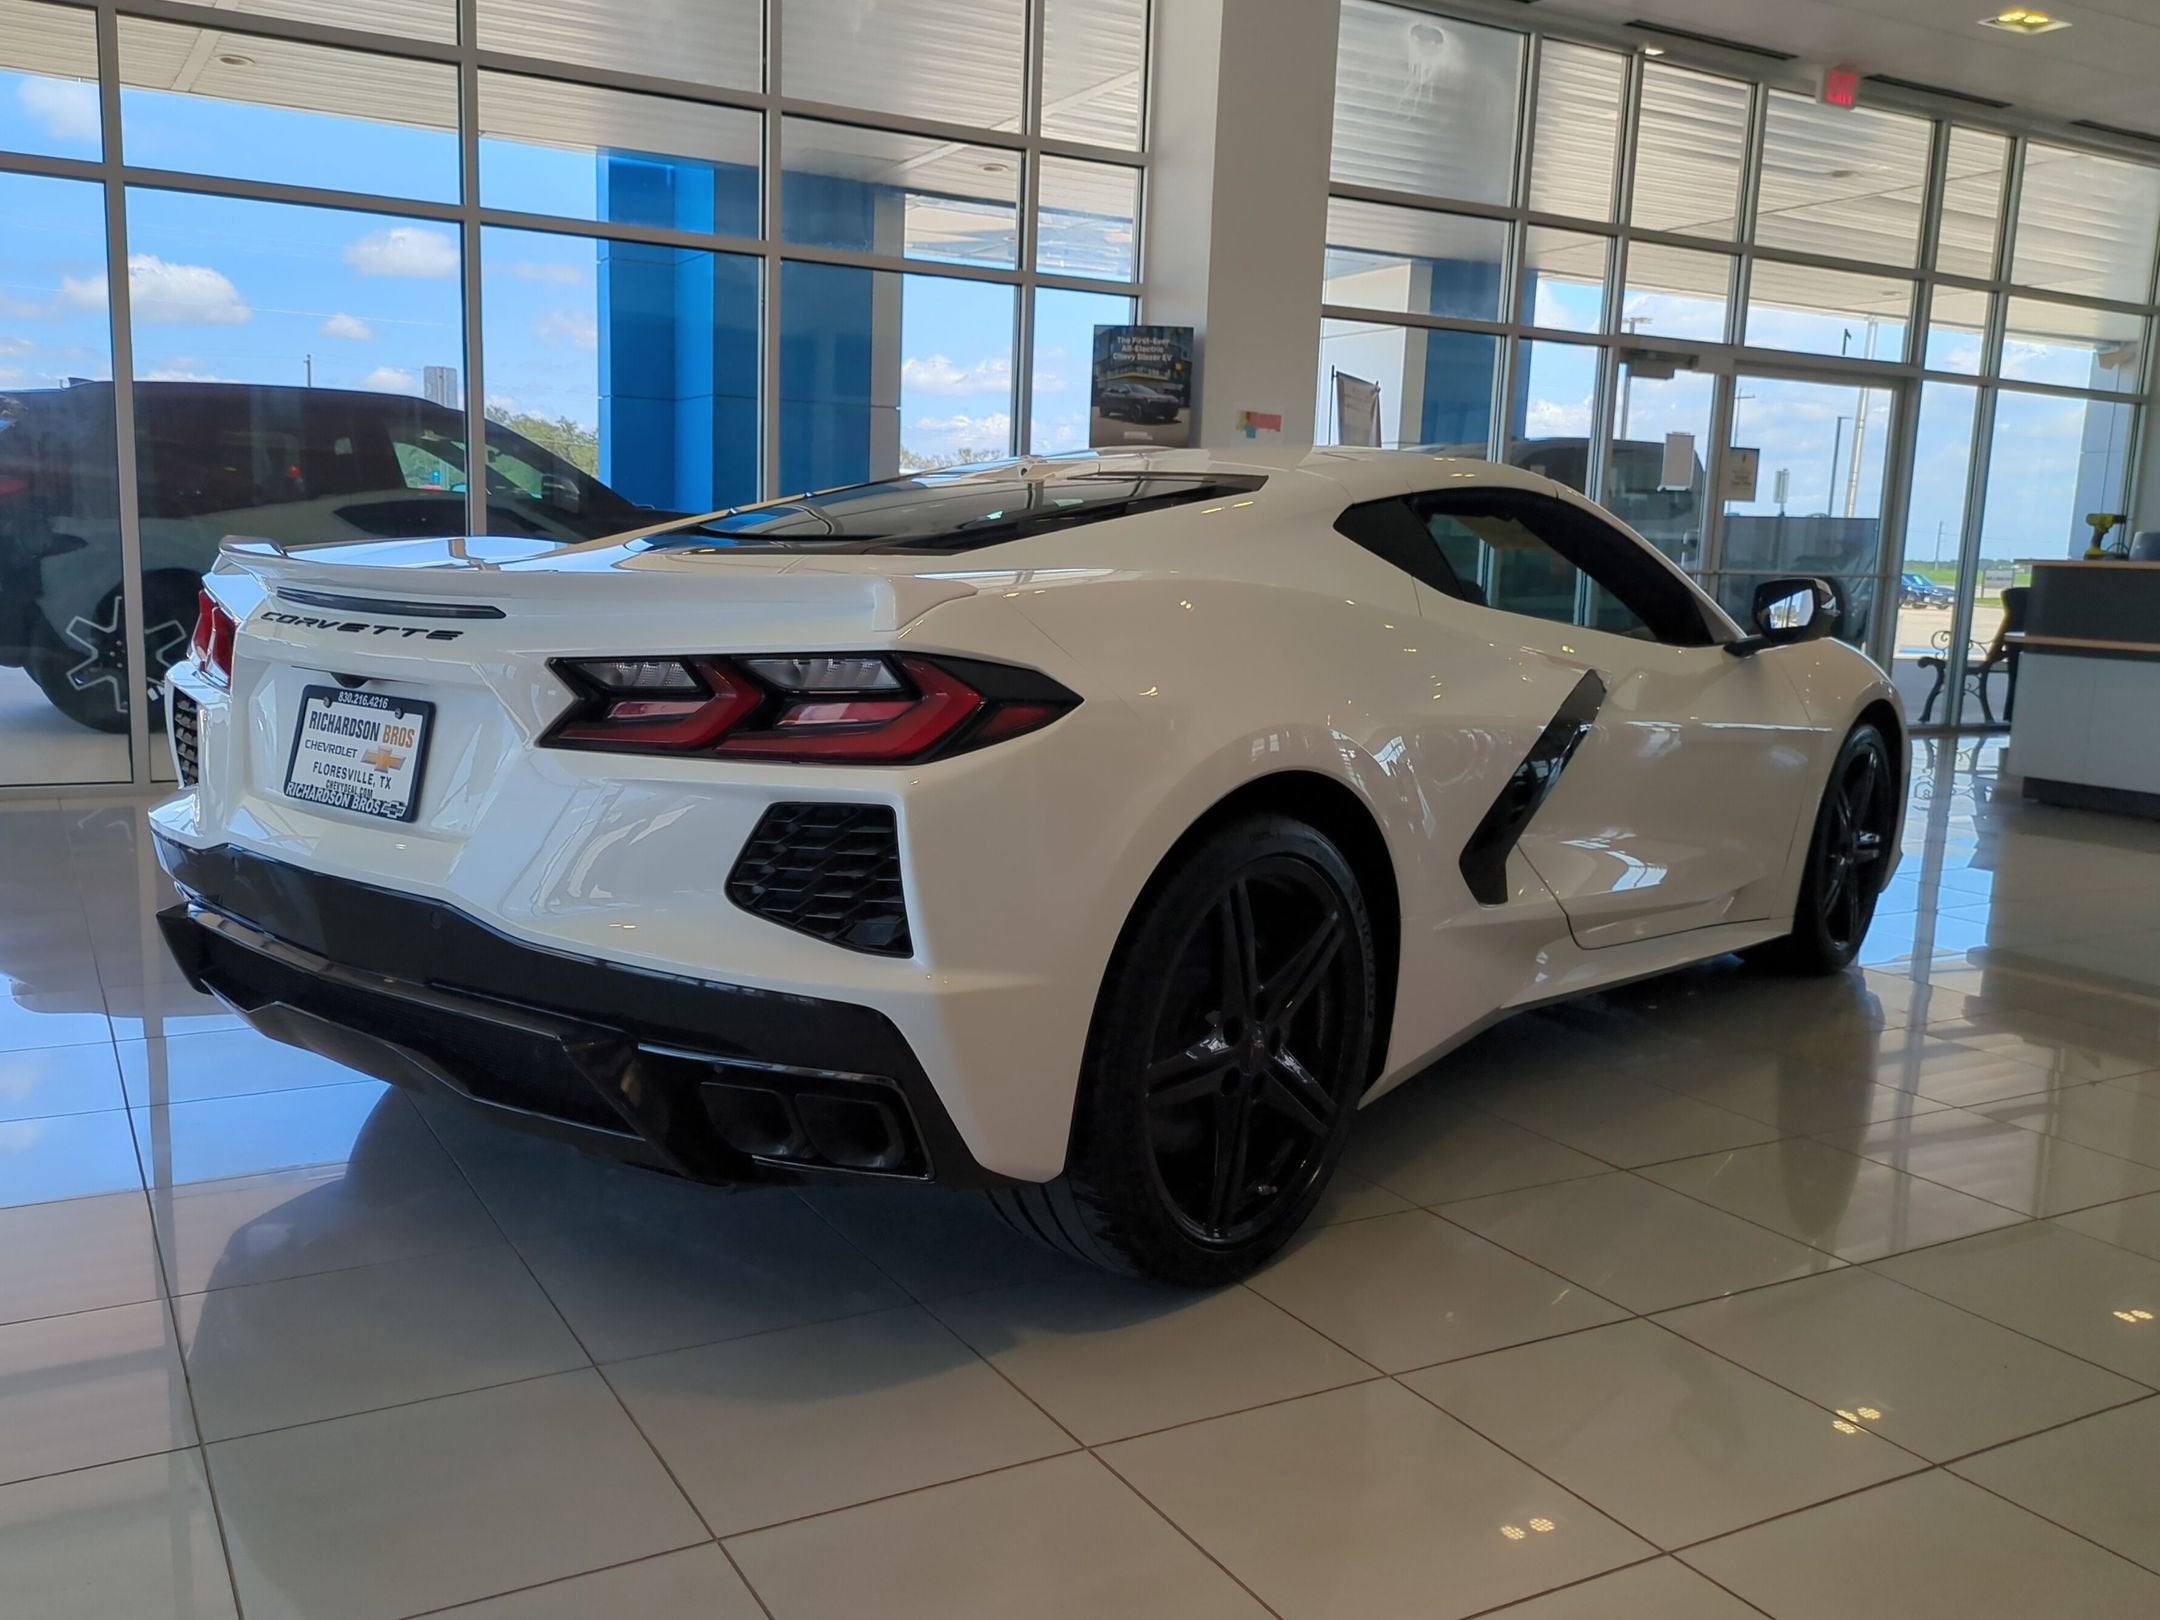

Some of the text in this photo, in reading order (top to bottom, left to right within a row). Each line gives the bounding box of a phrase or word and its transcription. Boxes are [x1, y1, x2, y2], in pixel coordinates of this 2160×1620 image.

[261, 611, 464, 641] CORVETTE
[338, 691, 389, 709] 830.216.4216
[308, 710, 416, 749] RICHARDSON BROS
[305, 739, 358, 758] CHEVROLET
[312, 761, 392, 790] FLORESVILLE, TX
[325, 779, 374, 800] CHEVYDEAL.COM
[285, 781, 351, 808] RICHARDSON
[351, 794, 381, 815] BROS
